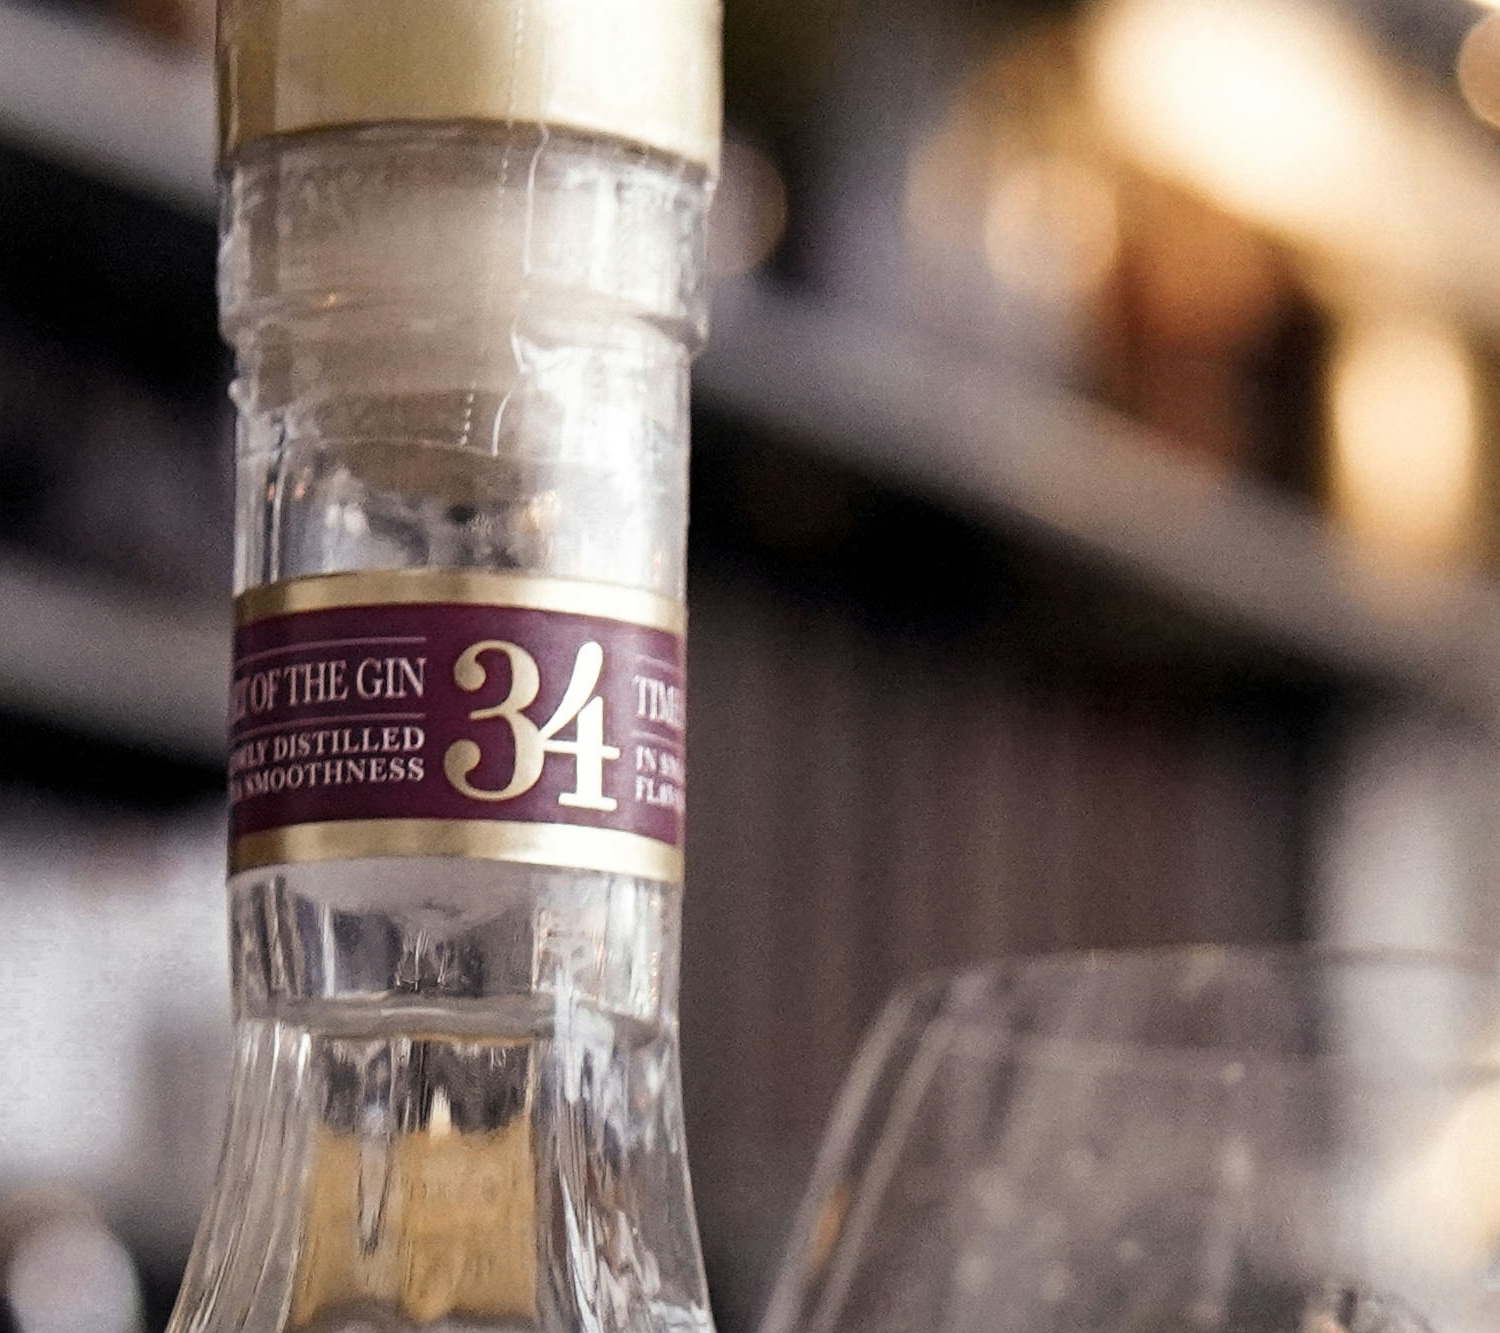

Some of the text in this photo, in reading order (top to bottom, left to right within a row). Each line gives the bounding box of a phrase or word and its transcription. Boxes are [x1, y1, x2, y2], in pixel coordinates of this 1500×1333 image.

[251, 669, 280, 713] OF
[284, 660, 349, 706] THE
[357, 657, 427, 699] GIN
[273, 726, 425, 762] DISTILLED
[443, 639, 621, 812] 34
[245, 757, 426, 794] SMOOTHNESS
